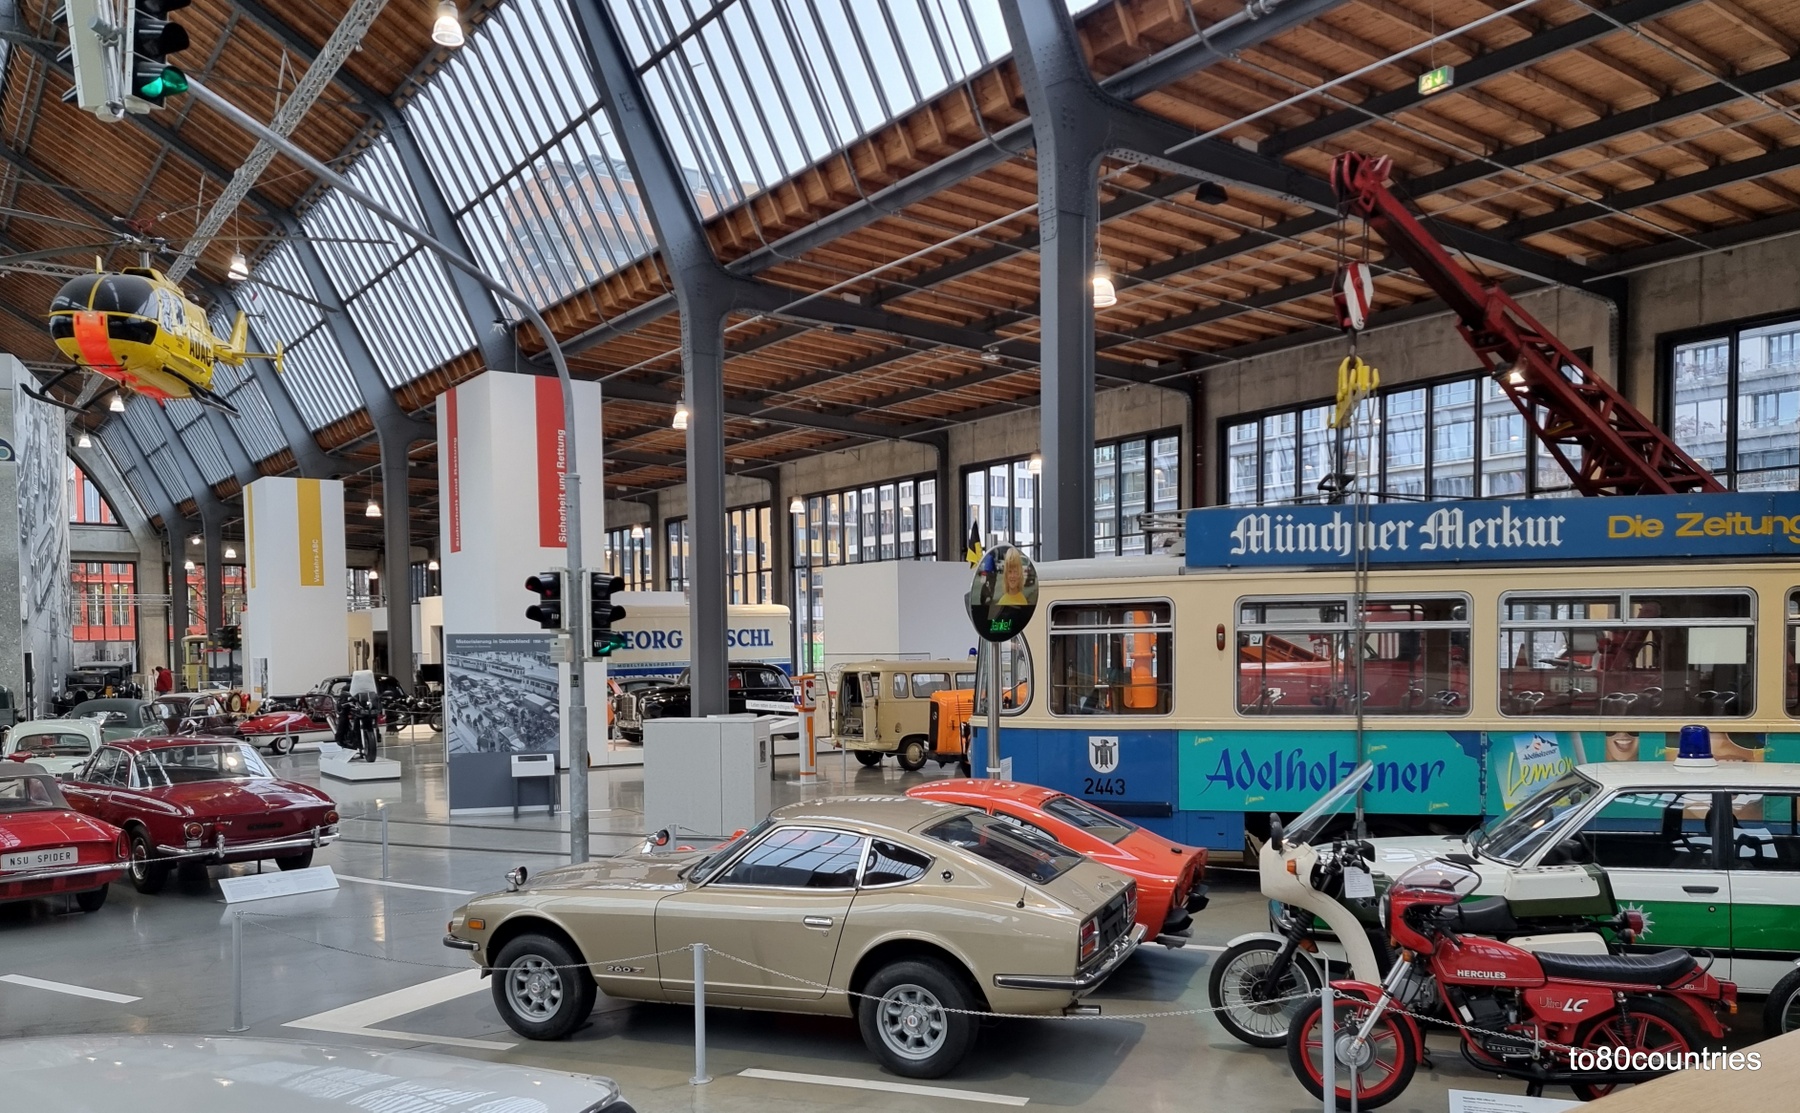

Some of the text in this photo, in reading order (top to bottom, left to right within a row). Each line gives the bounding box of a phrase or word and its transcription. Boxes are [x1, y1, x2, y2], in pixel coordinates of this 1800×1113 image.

[556, 428, 567, 543] Sicherheit und Rettung
[1230, 506, 1567, 557] Münchner Merkur
[1608, 514, 1664, 538] Die
[623, 628, 774, 650] EORG SCHL
[1084, 777, 1126, 796] 2443
[9, 851, 71, 866] NSU SPIDER
[1457, 969, 1506, 979] HERCULES
[1562, 997, 1589, 1013] LC
